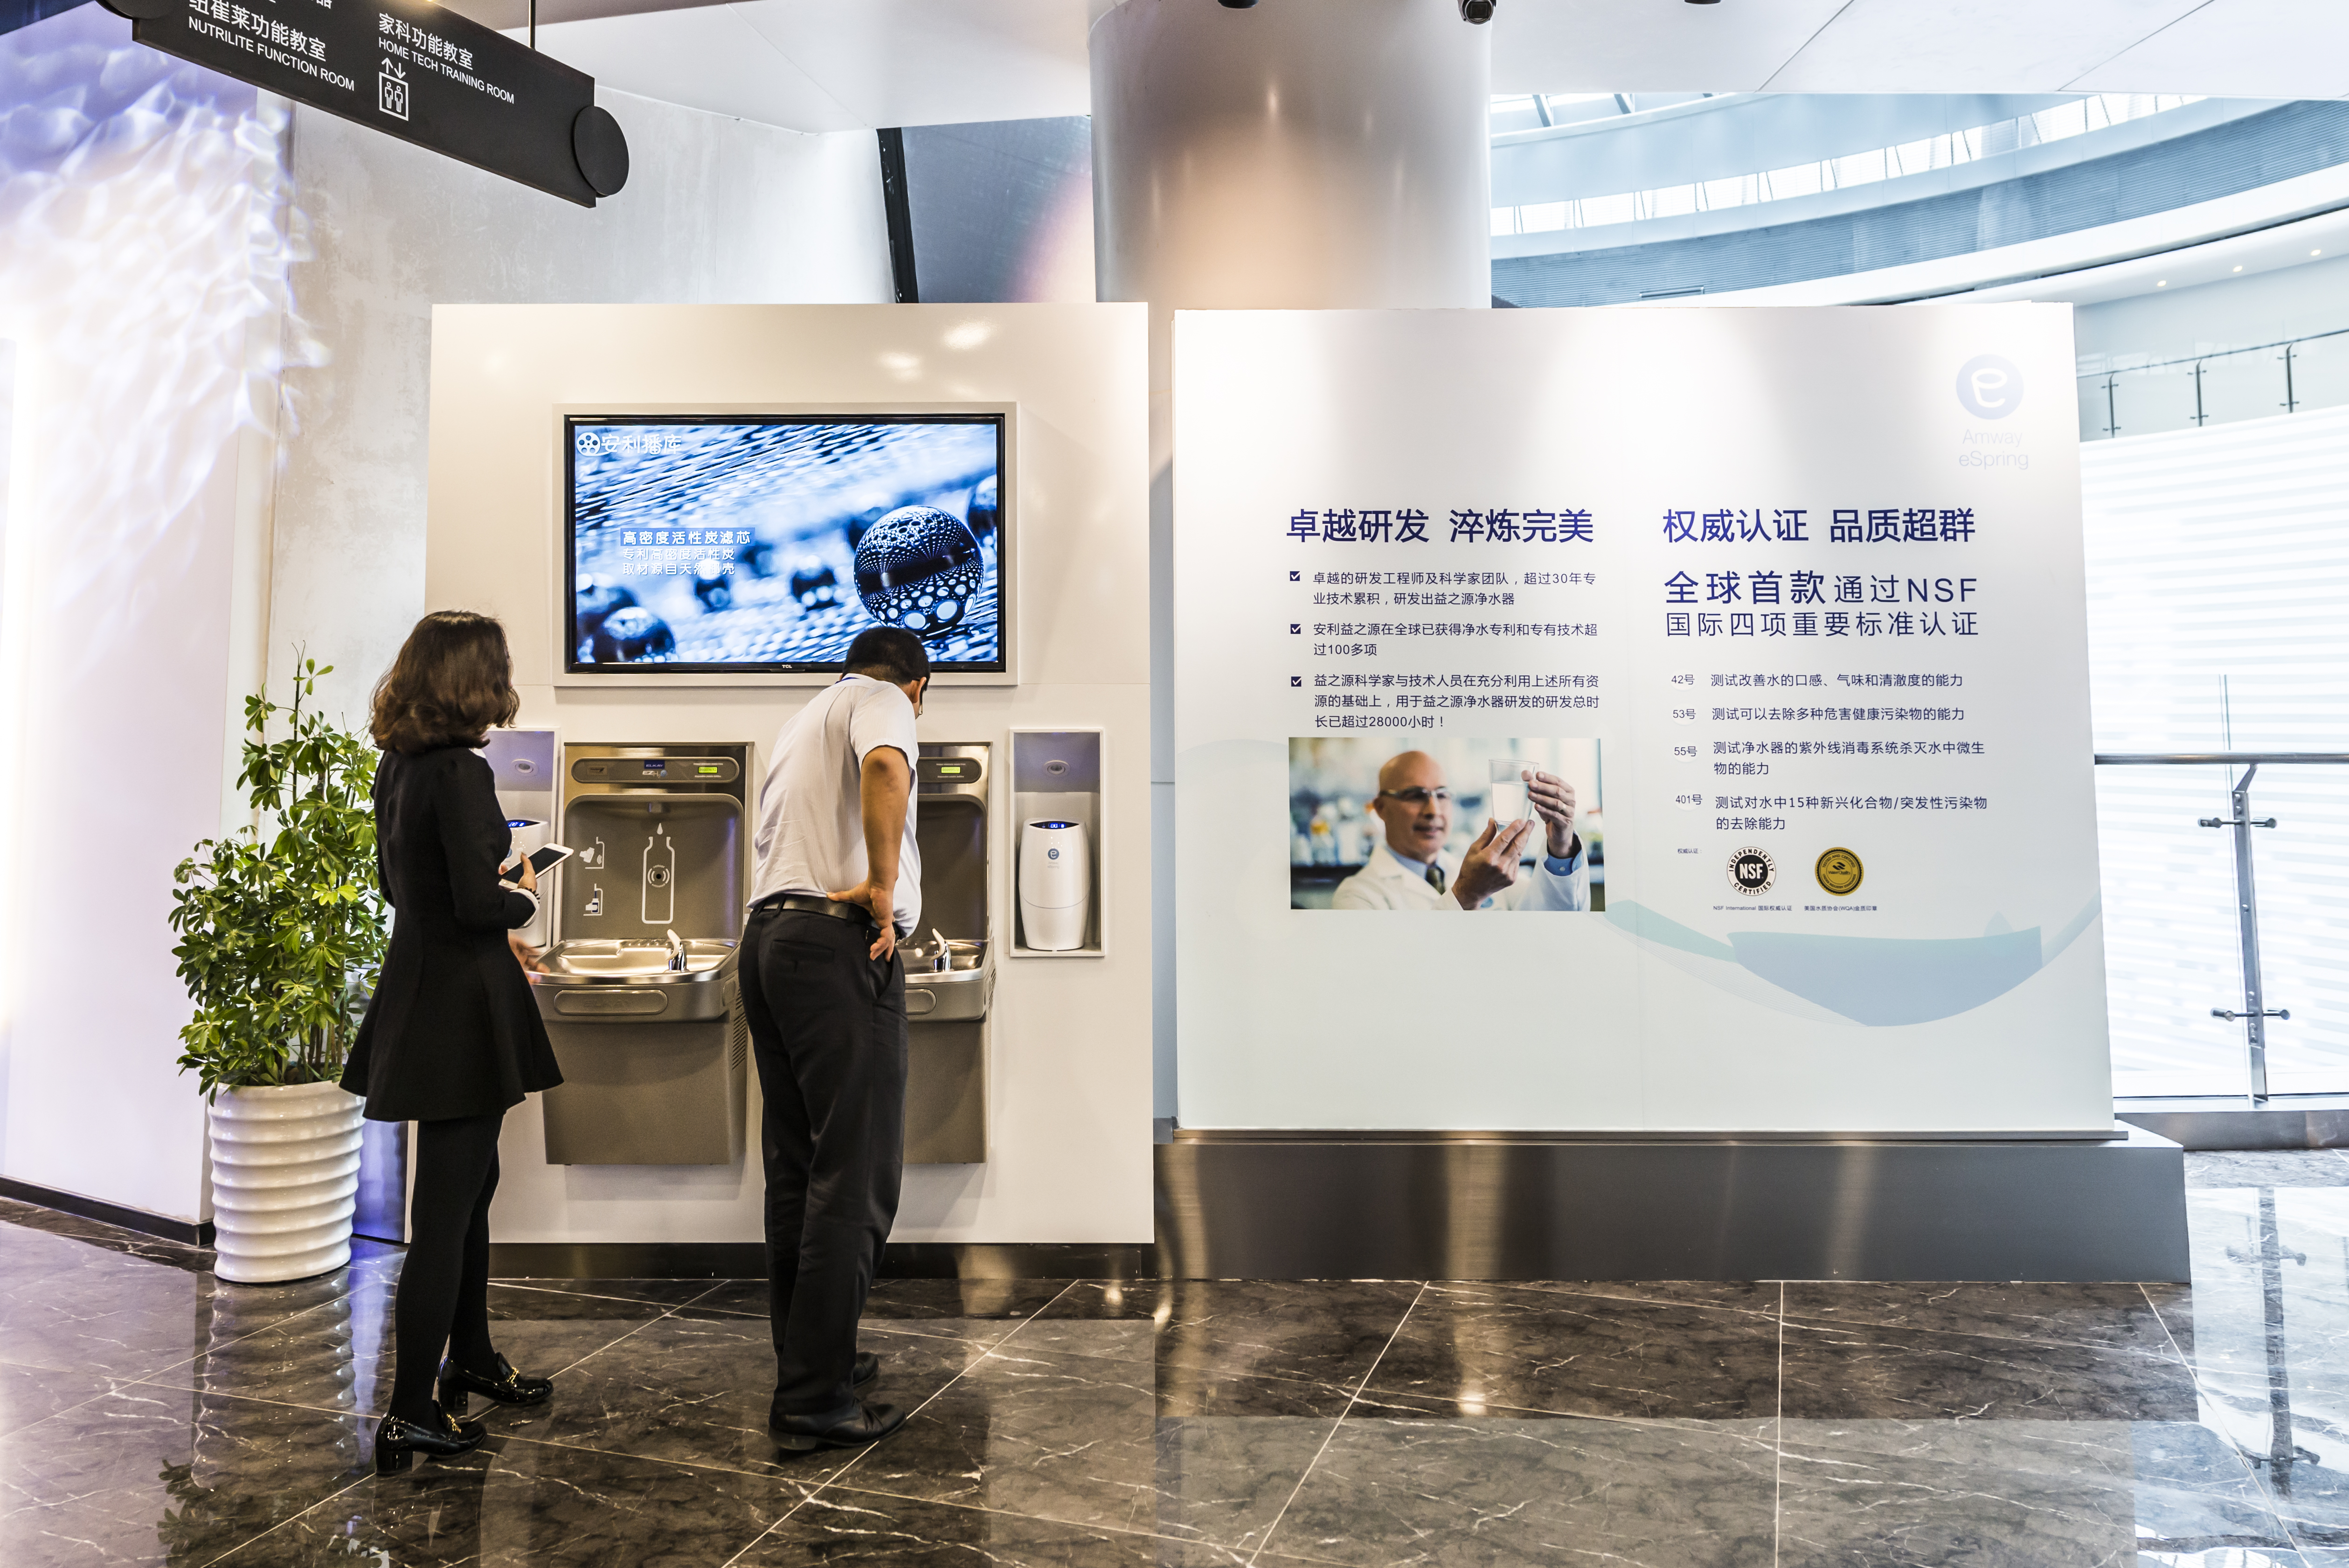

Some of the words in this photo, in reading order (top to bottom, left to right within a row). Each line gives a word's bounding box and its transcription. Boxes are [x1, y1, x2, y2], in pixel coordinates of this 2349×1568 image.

[189, 0, 326, 62] 纽崔莱功能教室
[379, 13, 473, 70] 家科功能教室
[189, 16, 254, 52] NUTRILITE
[257, 43, 317, 76] FUNCTION
[320, 68, 354, 91] ROOM
[379, 37, 409, 60] HOME
[412, 51, 438, 71] TECH
[440, 63, 485, 91] TRAINING
[487, 83, 514, 104] ROOM
[601, 434, 682, 455] 安利播库
[1962, 429, 2023, 448] Amway
[1959, 451, 2029, 470] eSpring
[1286, 509, 1430, 543] 卓越研发
[1449, 509, 1594, 543] 淬炼完美
[1663, 509, 1809, 543] 权威认证
[1830, 508, 1976, 543] 品质超群
[623, 531, 751, 545] 高密度活性炭滤芯
[623, 548, 735, 560] 专利高密度活性炭
[1313, 623, 1598, 637] 安利益之源在全球已获得净水专利和专有技术超
[1666, 611, 1979, 637] 国际四项重要标准认证
[1313, 643, 1378, 657] 过100多项
[1314, 674, 1600, 688] 益之源科学家与技术人员在充分利用上述所有资
[1671, 674, 1695, 686] 42号
[1673, 709, 1697, 720] 53号
[1712, 708, 1965, 721] 测试可以去除多种危害健康污染物的能力
[1674, 746, 1698, 757] 55号
[1713, 741, 1985, 755] 测试净水器的紫外线消毒系统杀灭水中微生
[1714, 762, 1769, 776] 物的能力
[1675, 794, 1703, 806] 401号
[1715, 796, 1988, 810] 测试对水中15种新兴化合物/突发性污染物
[1716, 817, 1786, 831] 的去除能力
[1729, 848, 1774, 872] INDEPENDENTLY
[1739, 863, 1763, 879] NSF
[1734, 881, 1771, 895] CERTIFIED
